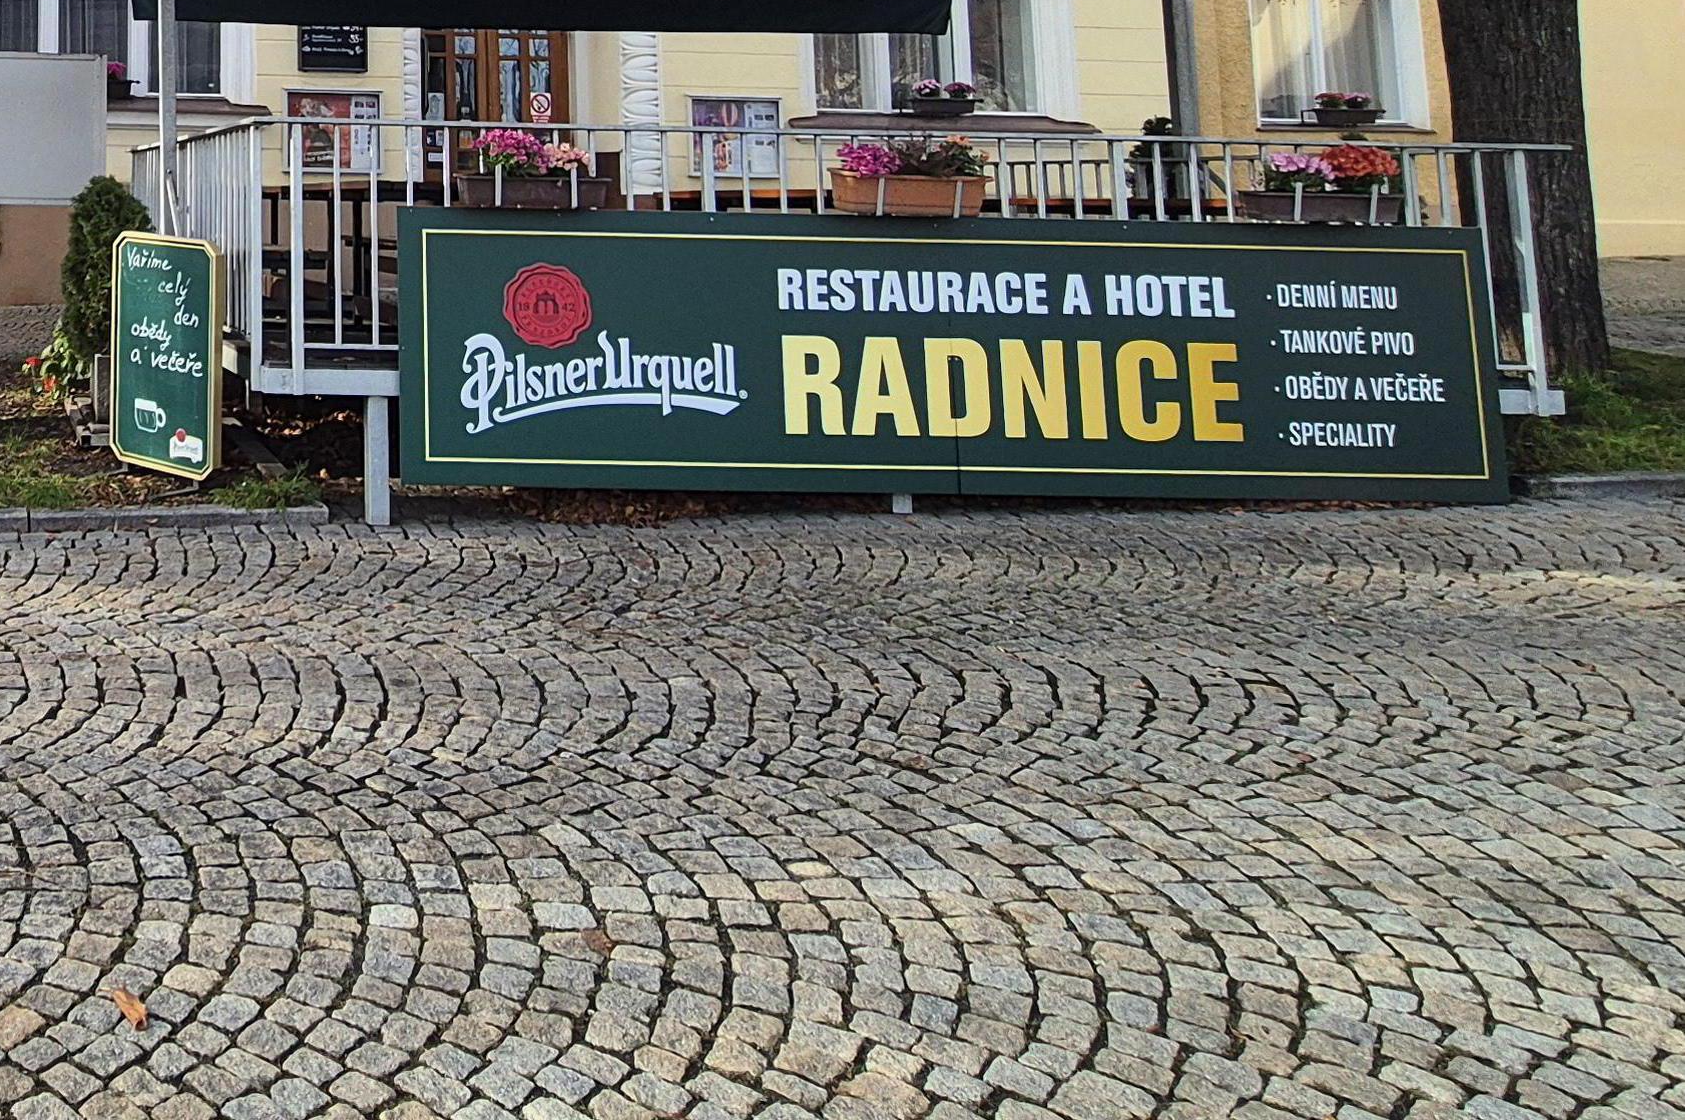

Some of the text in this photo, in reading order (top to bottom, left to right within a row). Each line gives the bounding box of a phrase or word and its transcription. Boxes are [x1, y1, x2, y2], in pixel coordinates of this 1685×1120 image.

[126, 244, 172, 270] Vaříme
[157, 271, 191, 306] celý
[777, 268, 1235, 318] RESTAURACE A HOTEL
[1276, 280, 1399, 310] DENNÍ MENU
[174, 304, 199, 328] den
[131, 316, 172, 351] obědy
[1280, 326, 1415, 356] TANKOVÉ PIVO
[151, 350, 203, 377] večeře
[460, 330, 738, 434] Pilsner Urquell
[781, 334, 1245, 442] RADNICE
[1285, 371, 1446, 403] OBĚDY A VEČEŘE
[1289, 421, 1396, 448] SPECIALITY
